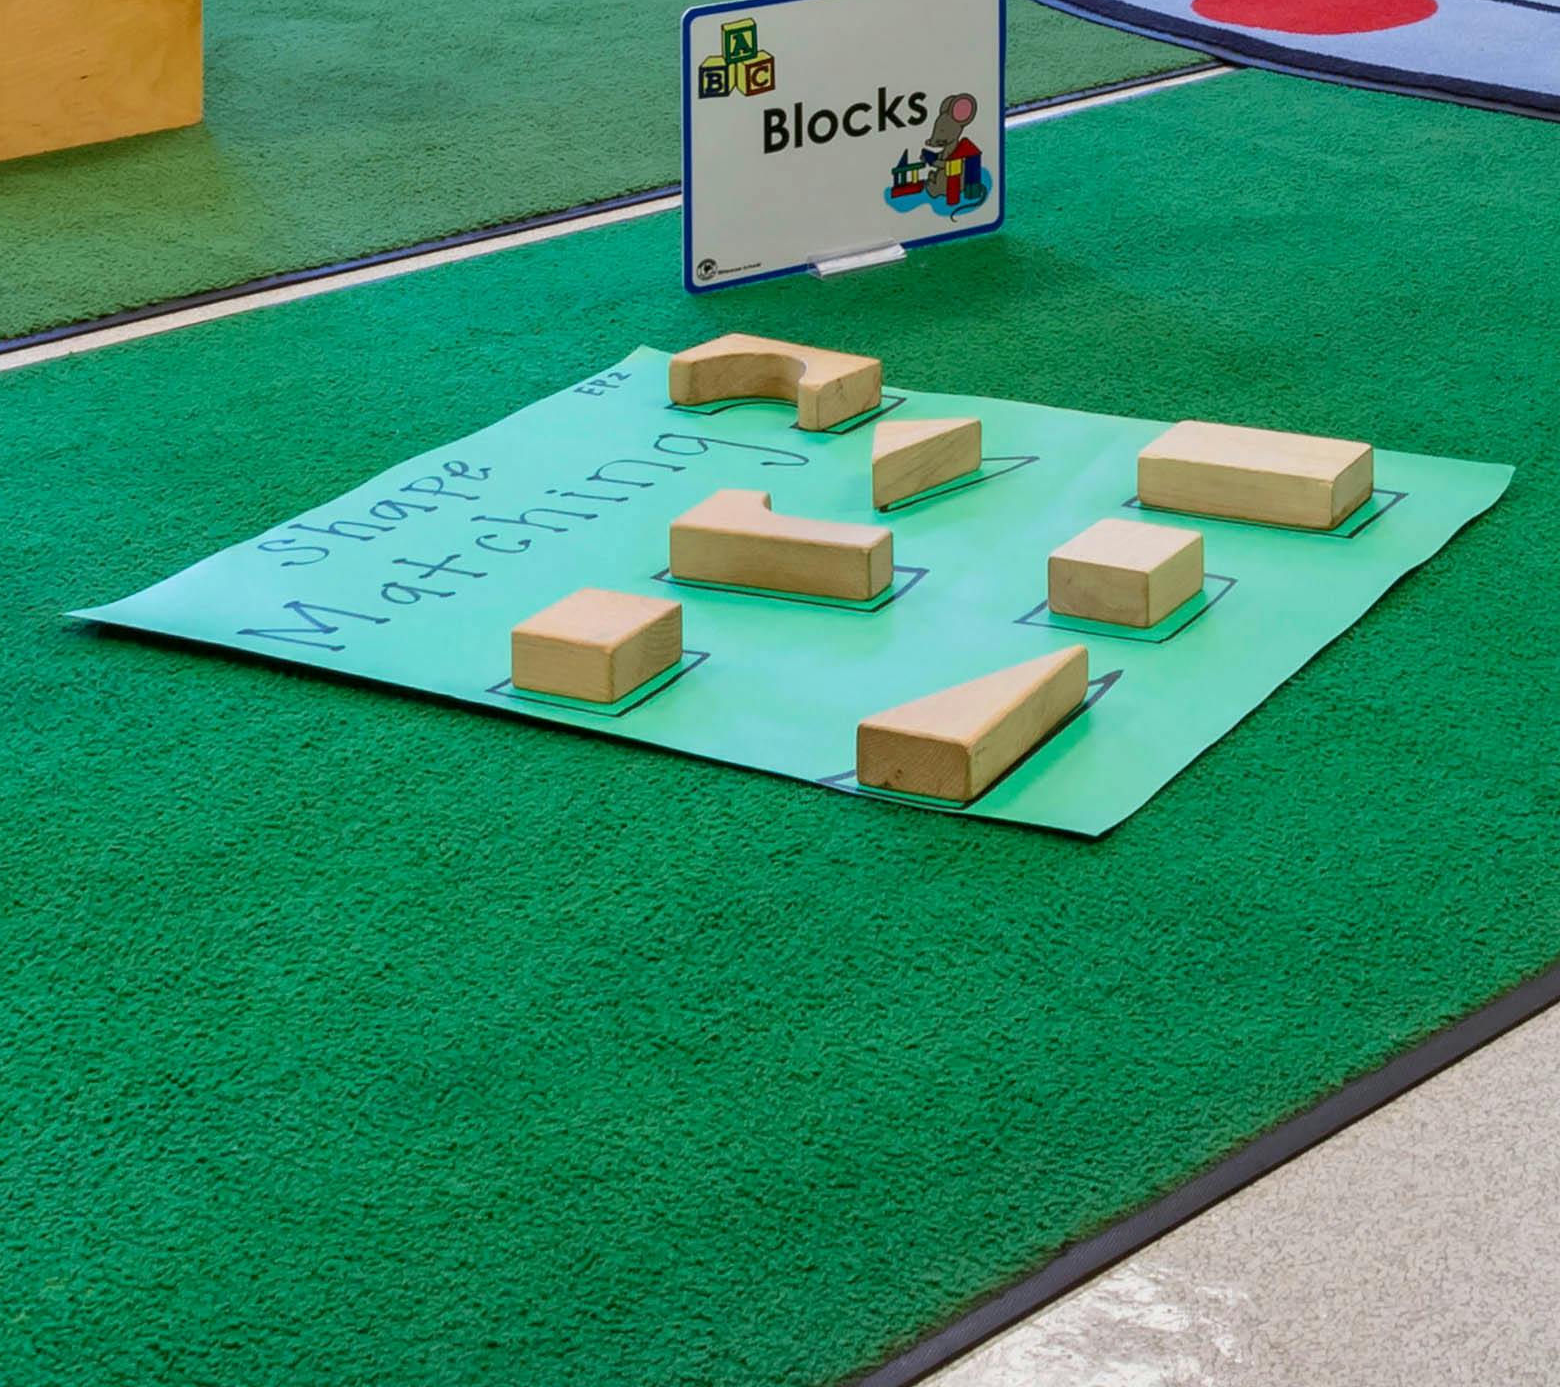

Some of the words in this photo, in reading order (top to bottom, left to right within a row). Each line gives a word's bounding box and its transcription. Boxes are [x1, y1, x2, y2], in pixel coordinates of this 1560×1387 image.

[730, 32, 753, 57] A
[704, 72, 723, 92] B
[751, 66, 769, 87] C
[763, 86, 929, 154] Blocks
[238, 433, 810, 653] Matching
